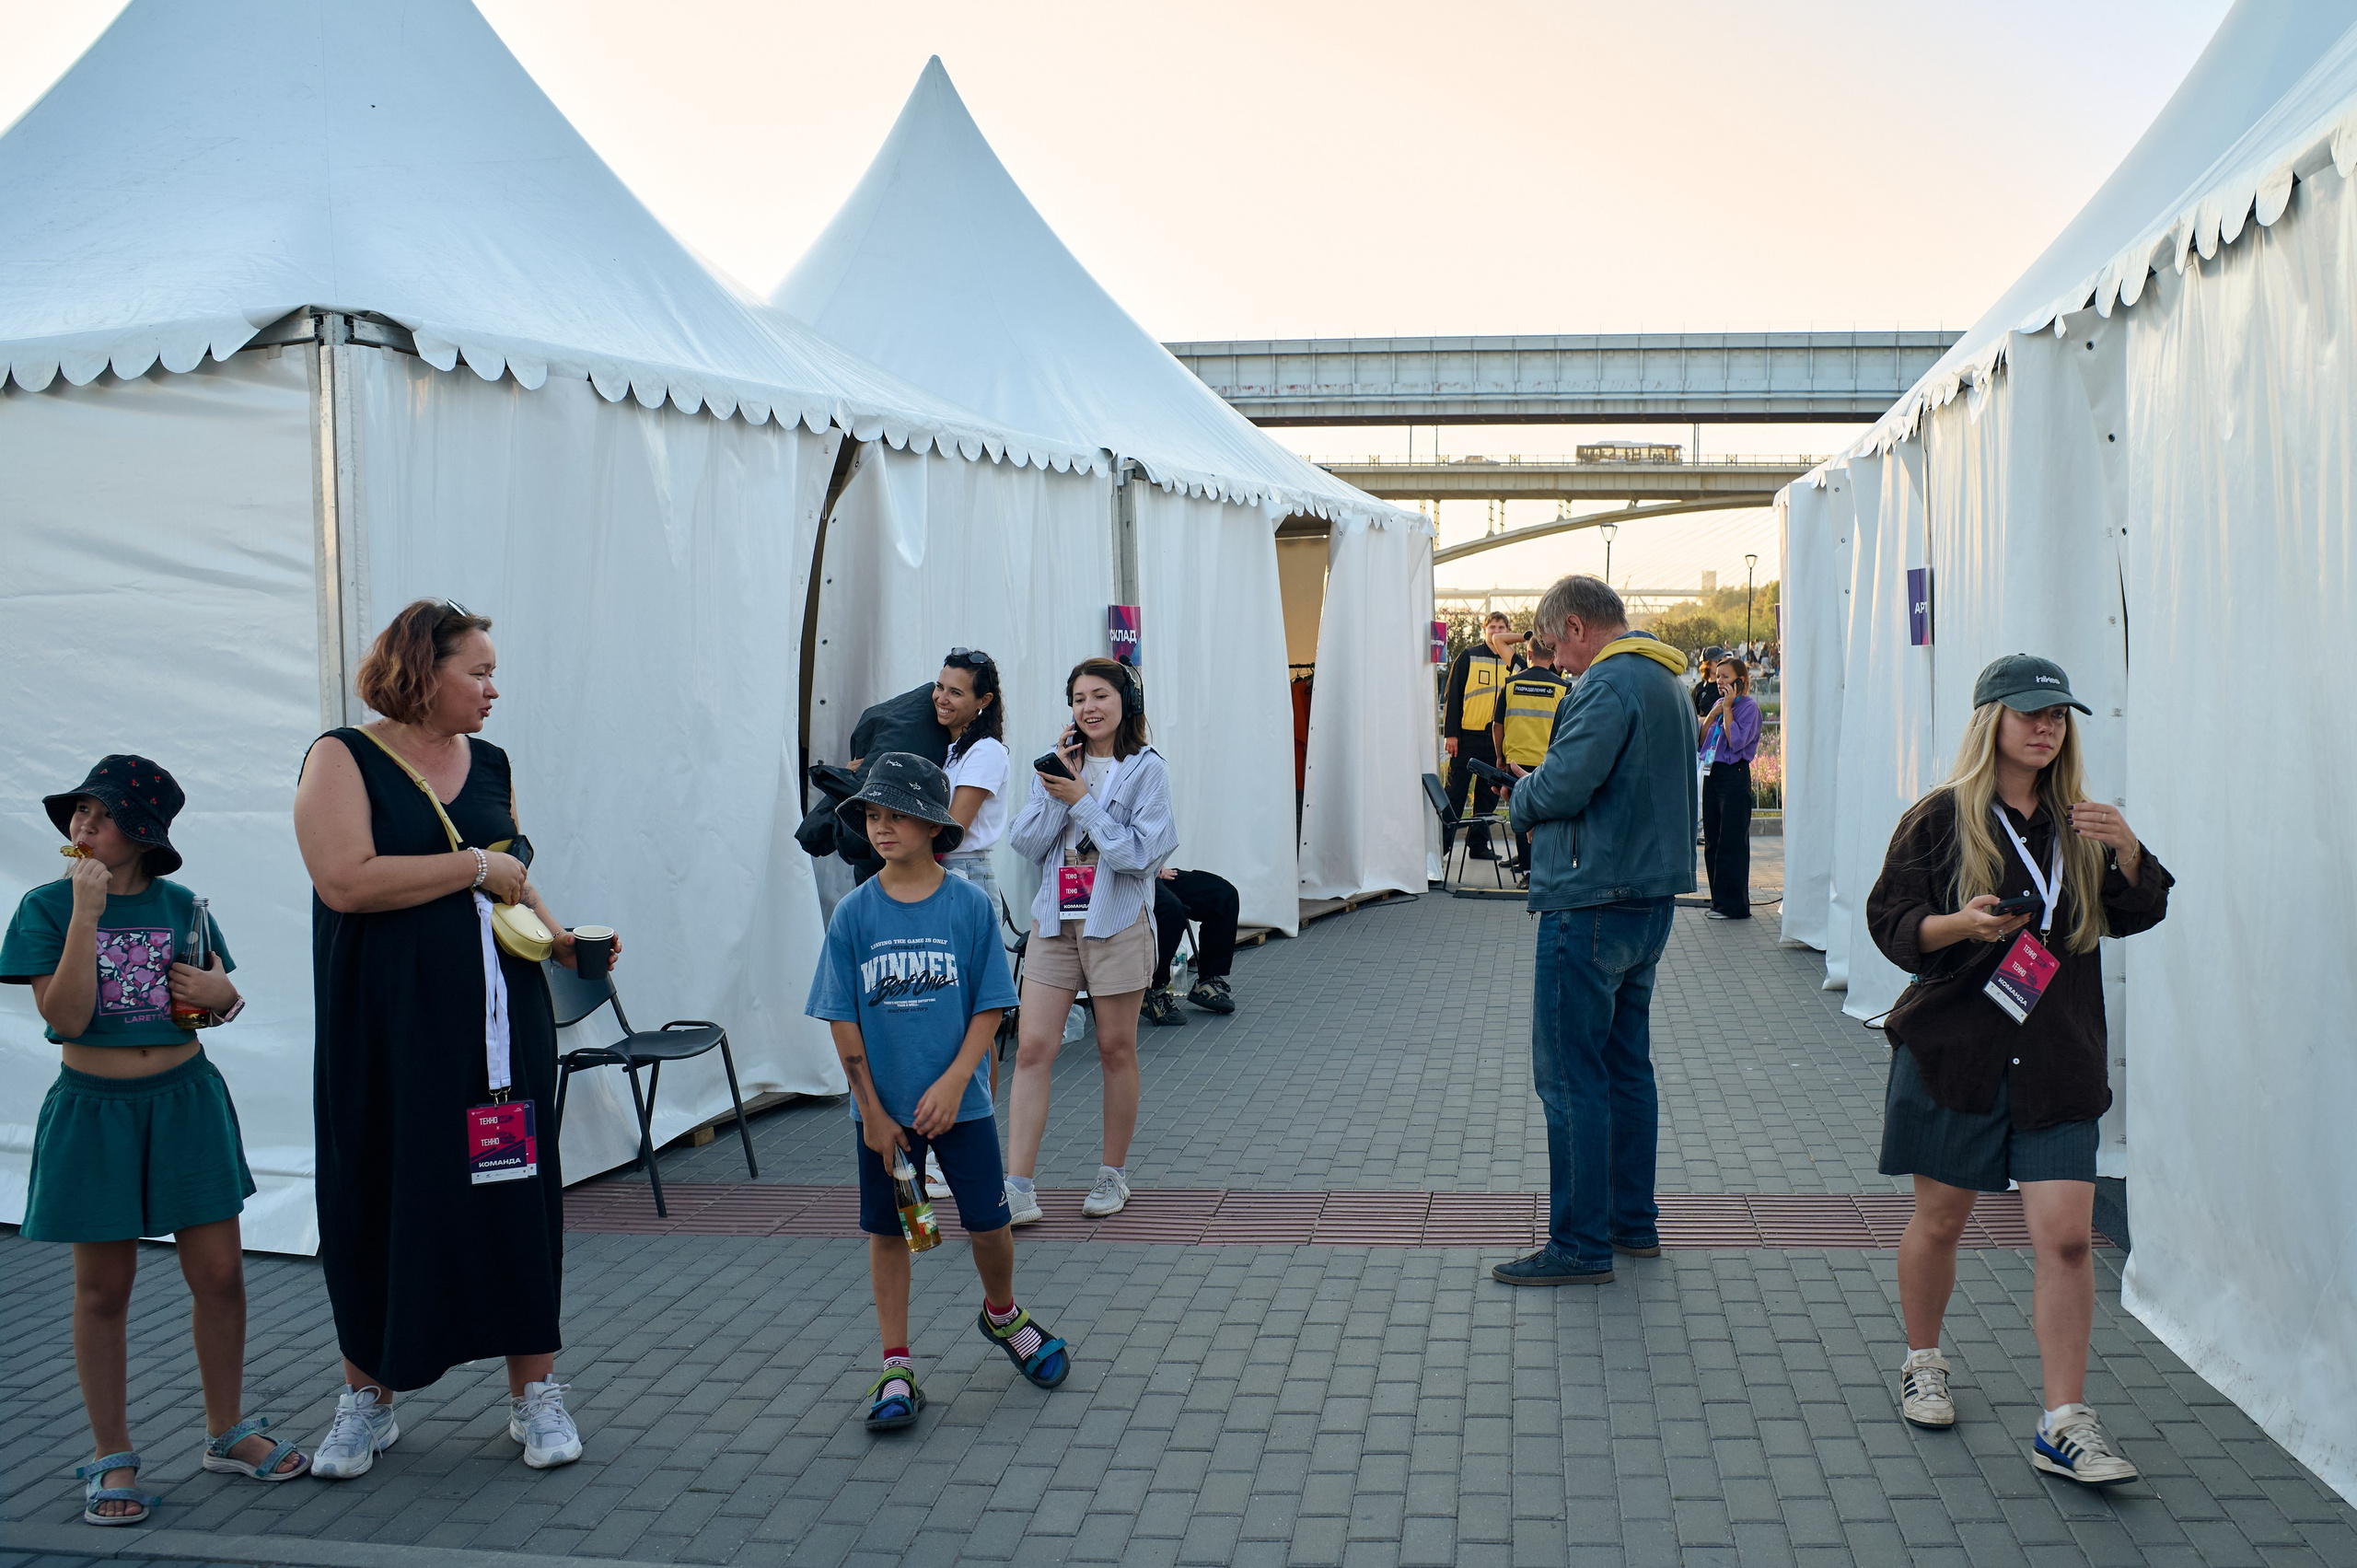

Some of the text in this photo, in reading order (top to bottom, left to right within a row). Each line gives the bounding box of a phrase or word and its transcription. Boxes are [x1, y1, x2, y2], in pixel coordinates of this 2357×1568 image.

[1109, 629, 1137, 645] СКЛАД
[861, 951, 959, 994] WINNER
[1998, 977, 2028, 1006] КОМАНДА
[479, 1116, 498, 1125] ТЕХНО
[481, 1137, 500, 1146] ТЕХНО
[479, 1157, 522, 1168] КОМАНДА
